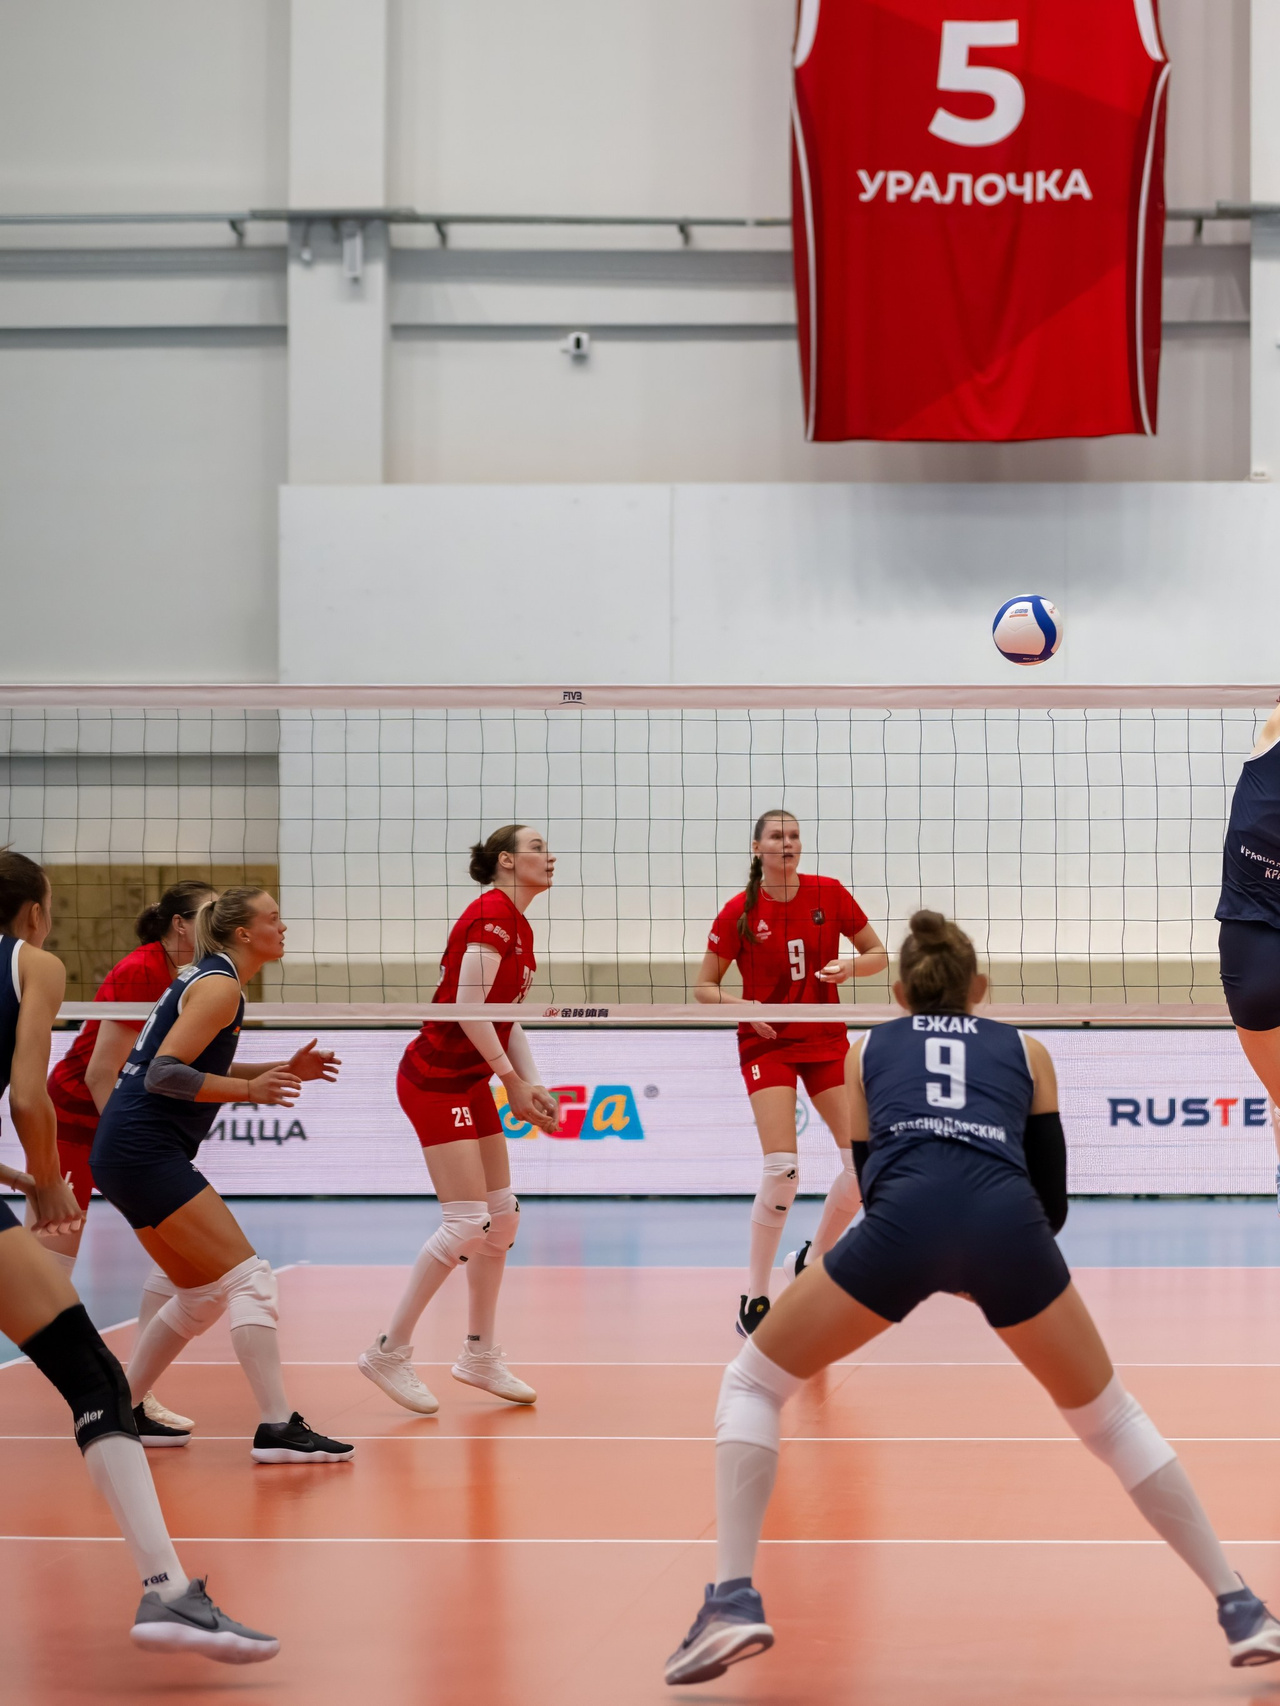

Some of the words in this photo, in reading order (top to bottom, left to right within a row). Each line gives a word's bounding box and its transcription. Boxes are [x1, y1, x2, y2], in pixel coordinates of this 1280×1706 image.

[928, 19, 1026, 147] 5
[857, 168, 1093, 205] УРАЛОЧКА
[562, 691, 583, 701] FIVB
[787, 938, 806, 981] 9
[912, 1015, 979, 1034] ЕЖАК
[751, 1064, 761, 1081] 9
[925, 1037, 966, 1110] 9
[451, 1106, 474, 1128] 29
[205, 1118, 308, 1146] ИЦЦА
